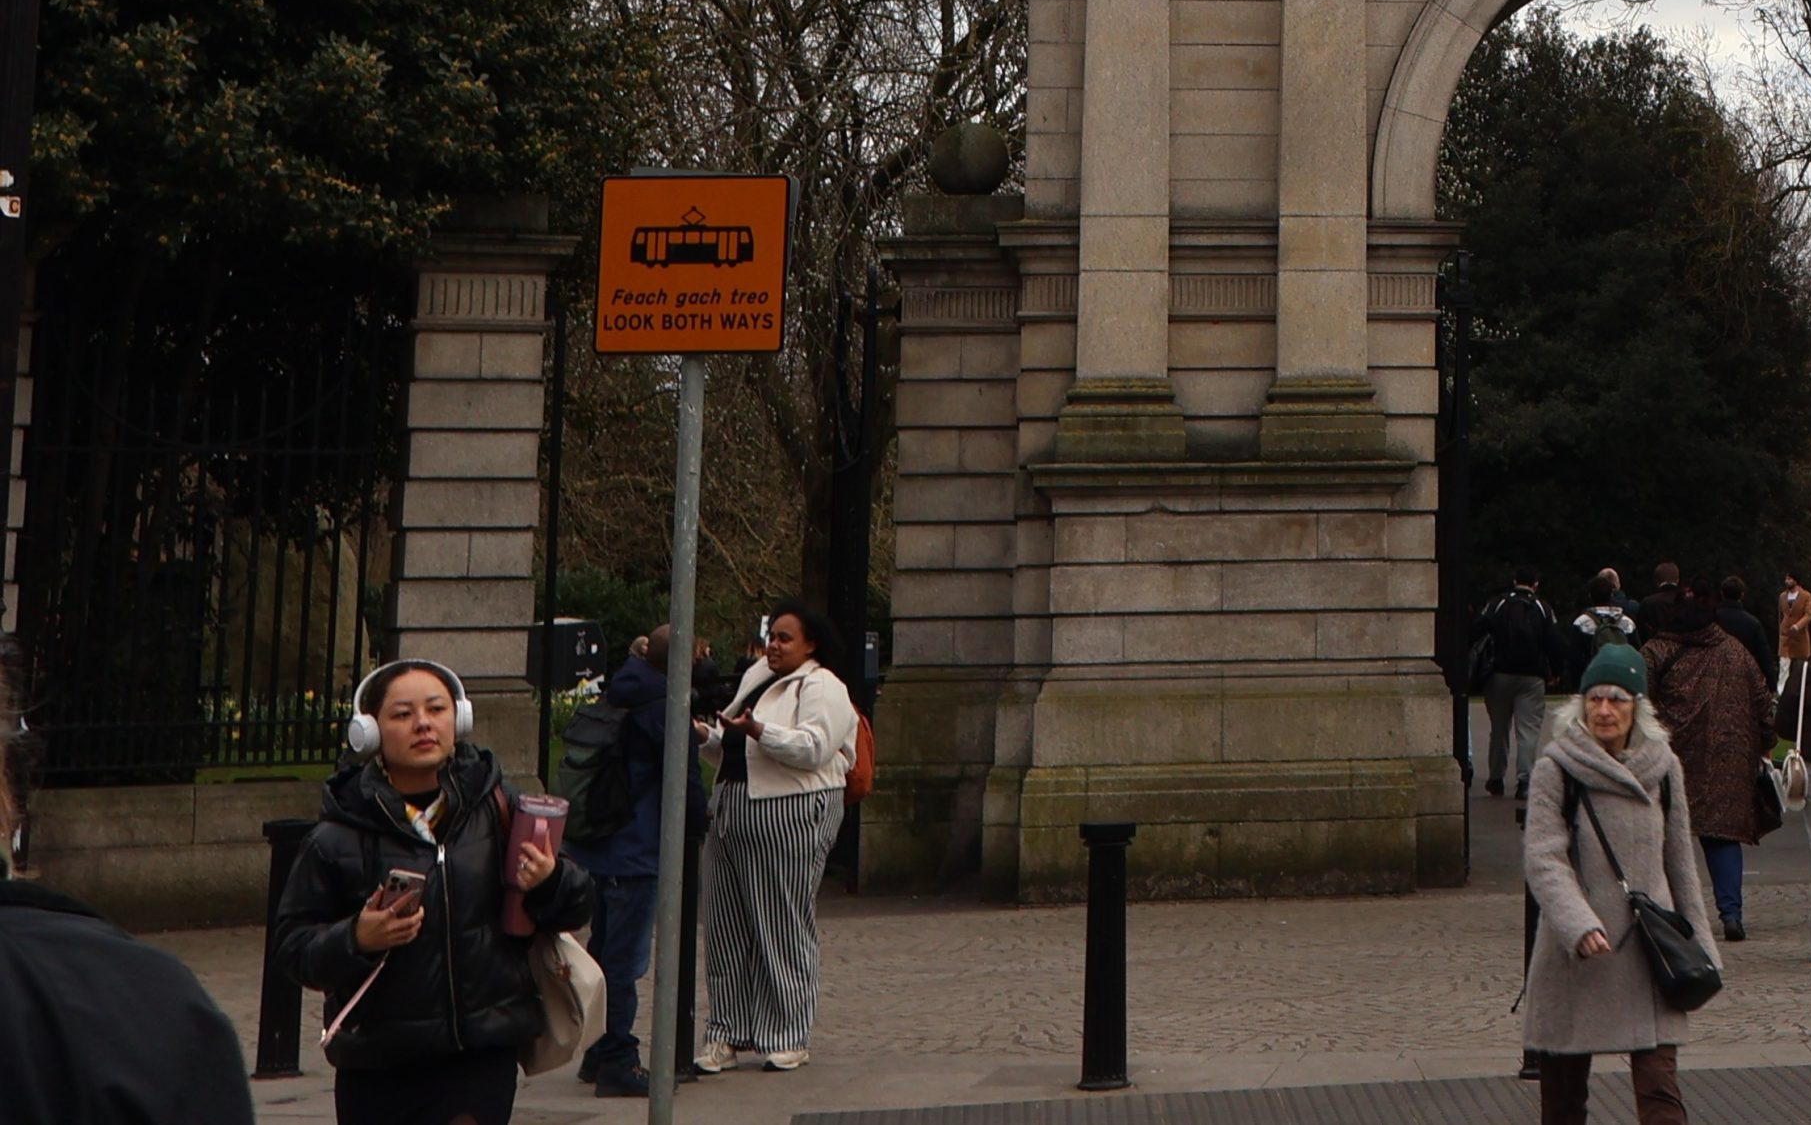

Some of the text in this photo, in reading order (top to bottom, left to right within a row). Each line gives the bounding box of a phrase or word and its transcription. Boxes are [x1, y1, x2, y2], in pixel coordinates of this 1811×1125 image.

[675, 288, 722, 308] gach
[731, 288, 769, 305] treo
[603, 313, 774, 331] LOOK BOTH WAYS
